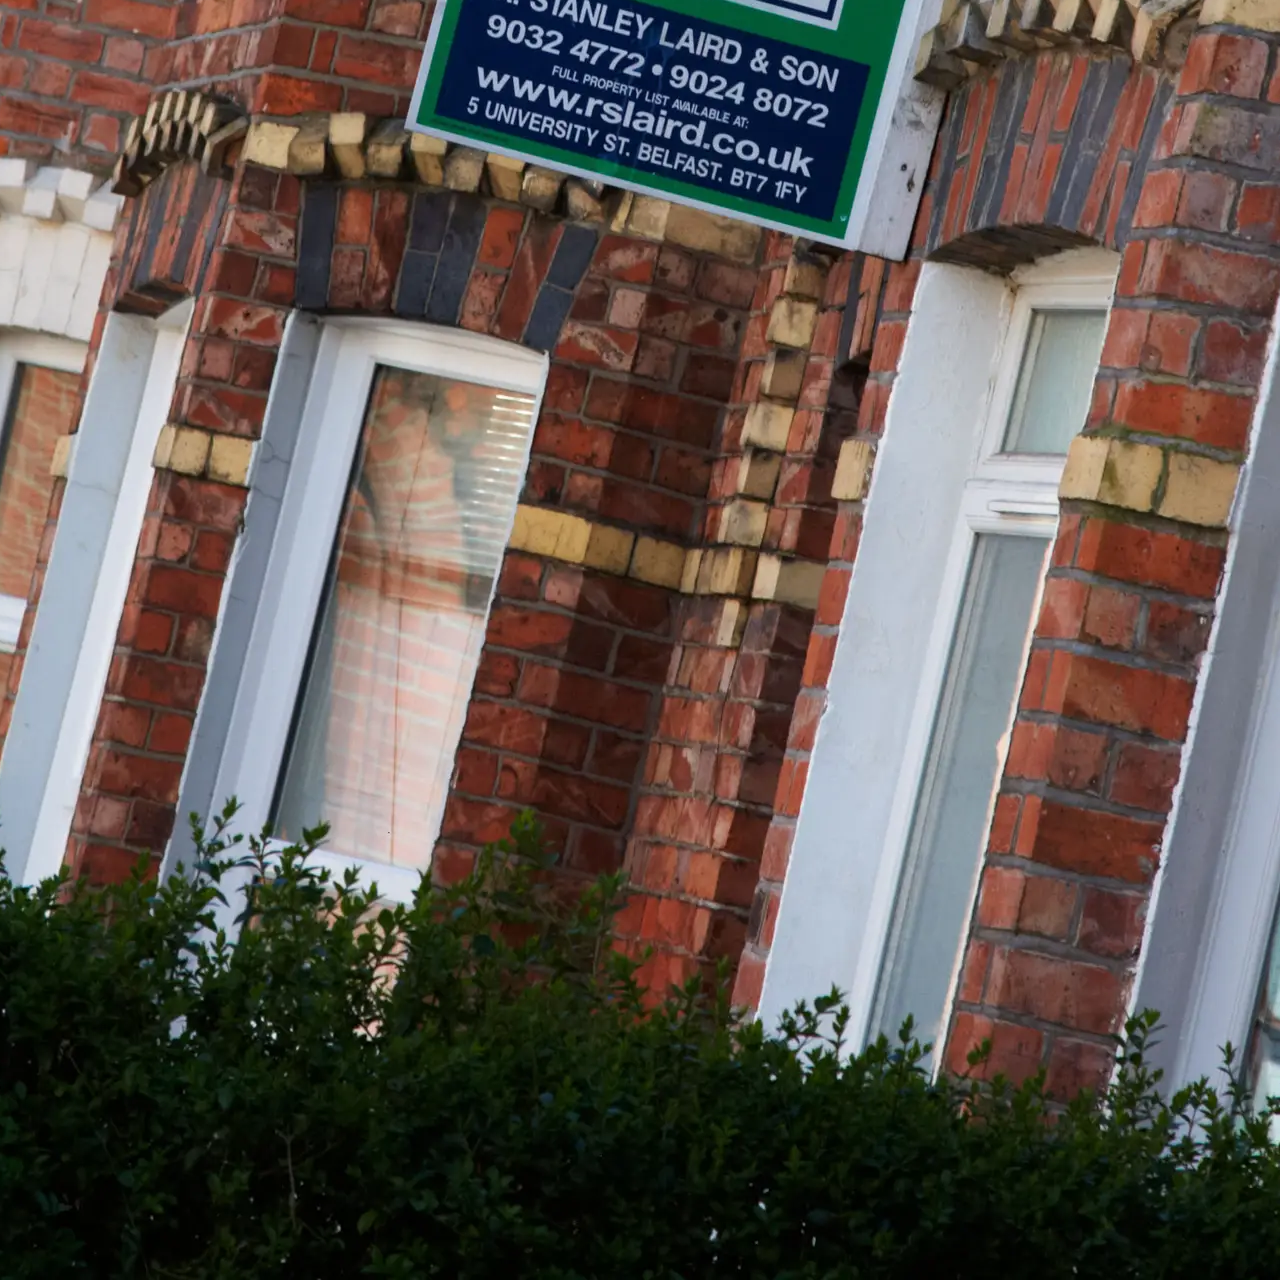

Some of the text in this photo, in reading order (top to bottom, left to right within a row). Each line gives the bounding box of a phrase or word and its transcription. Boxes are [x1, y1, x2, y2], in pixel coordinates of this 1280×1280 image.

[487, 14, 830, 129] 9032 4772 9024 8072
[552, 65, 749, 129] FULL PROPERTY LIST AVAILABLE AT:
[659, 21, 742, 65] LAIRD
[749, 48, 769, 73] &
[779, 55, 839, 92] SON
[466, 96, 480, 115] 5
[485, 99, 600, 148] UNIVERSITY
[603, 133, 631, 157] ST.
[638, 142, 723, 183] BELFAST.
[730, 168, 769, 194] BT7
[774, 181, 808, 205] 1FY
[477, 65, 815, 178] www.rslaird.co.uk
